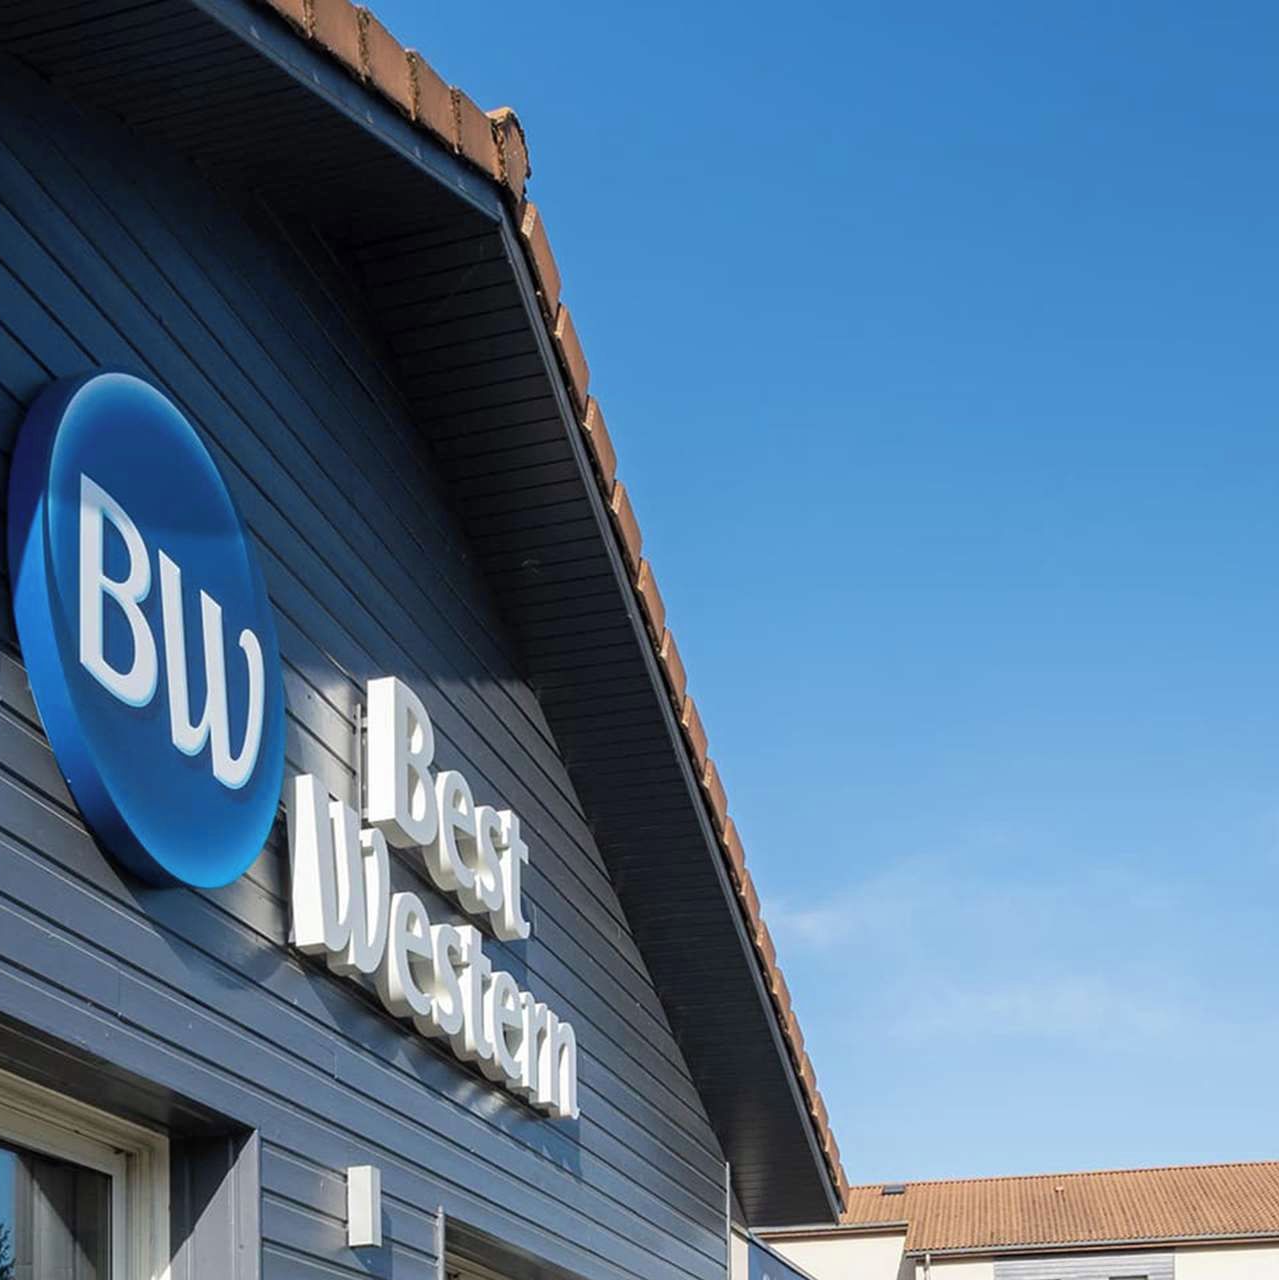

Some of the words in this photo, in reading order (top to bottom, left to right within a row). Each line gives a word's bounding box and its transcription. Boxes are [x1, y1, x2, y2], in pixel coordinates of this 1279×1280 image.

[80, 472, 266, 790] BW
[287, 774, 581, 1120] Western
[368, 676, 531, 942] Best
